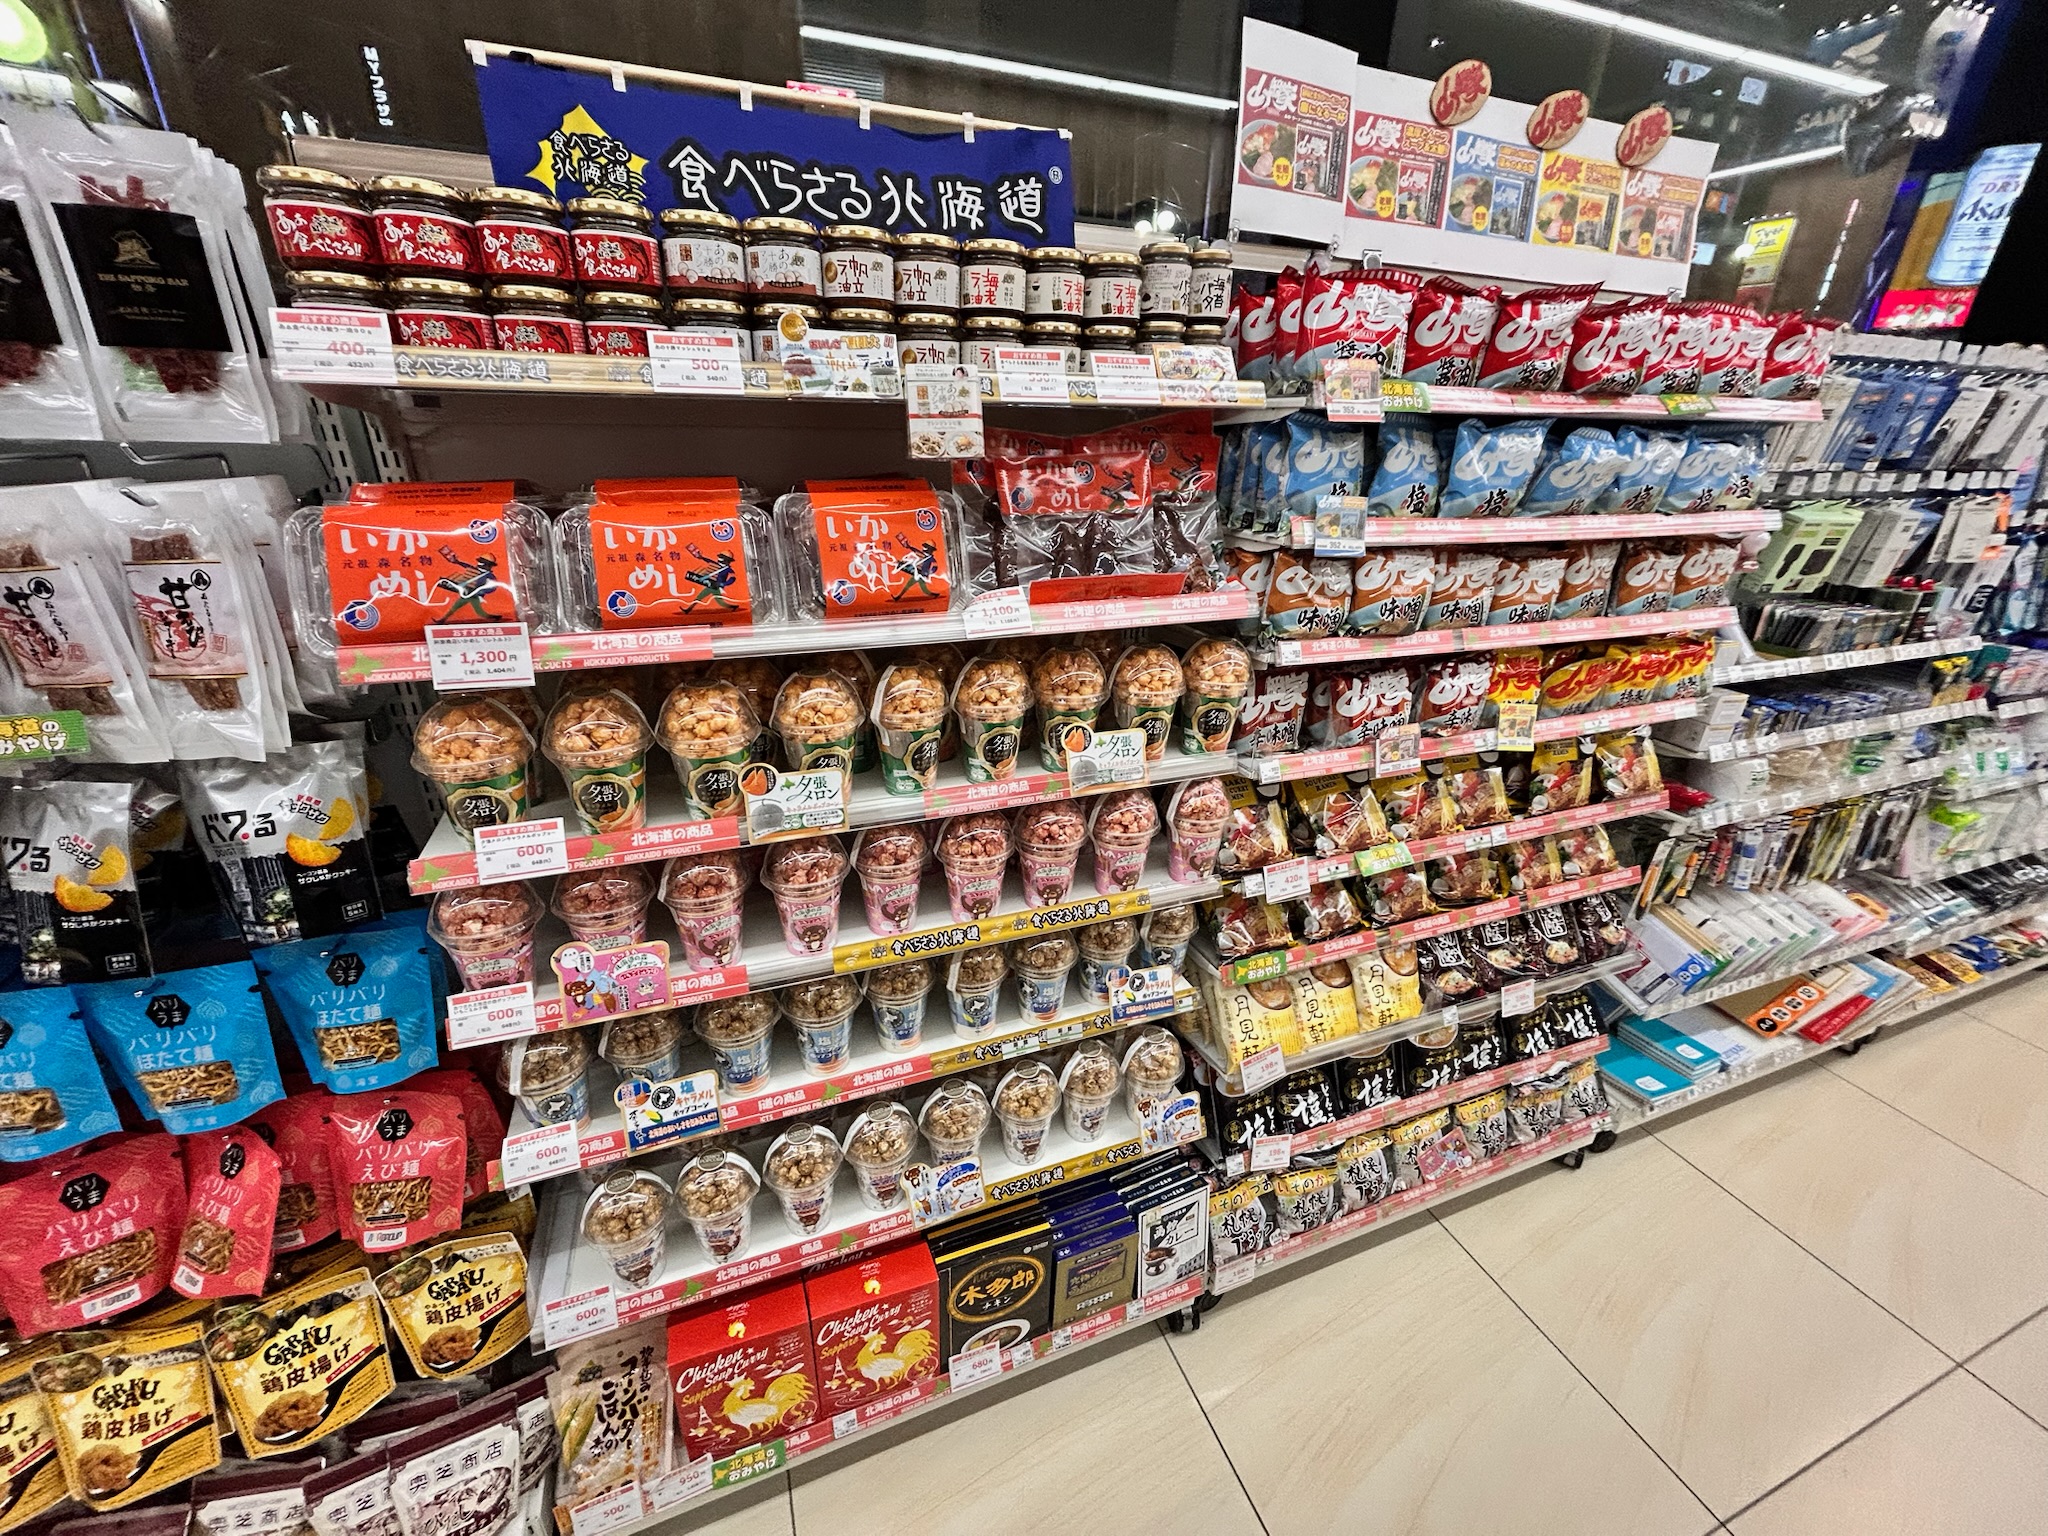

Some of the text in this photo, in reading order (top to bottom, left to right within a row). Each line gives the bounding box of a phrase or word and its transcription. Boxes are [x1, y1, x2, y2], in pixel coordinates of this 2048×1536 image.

[550, 129, 630, 162] 食べらさる
[553, 155, 629, 188] 北海道
[668, 144, 1045, 234] 食べらさる北海道
[97, 272, 190, 287] THE SAPPORO BAR
[395, 354, 551, 381] 食べらさる北海道
[1381, 383, 1420, 397] 北海道の
[1381, 396, 1424, 409] おみやげ
[1051, 488, 1092, 510] めし
[1405, 481, 1428, 516] 塩
[604, 526, 678, 551] いか
[826, 515, 889, 540] いか
[339, 528, 429, 556] いか
[369, 570, 450, 606] めし
[628, 564, 696, 598] めし
[1297, 607, 1345, 633] 味噌
[1379, 596, 1424, 625] 味噌
[1440, 598, 1484, 625] 味噌
[591, 633, 684, 651] 北海道の商品
[460, 650, 517, 665] 1,300円
[583, 653, 671, 668] HOKKAIDO PRODUCTS
[364, 670, 413, 683] HOKKAIDO
[1106, 734, 1133, 750] 夕張
[1112, 746, 1141, 759] メロン
[588, 784, 615, 797] 夕張
[797, 774, 827, 792] 夕張
[804, 785, 840, 803] メロン
[594, 789, 622, 803] メロン
[631, 823, 714, 847] 北海道の商品
[516, 844, 554, 858] 600円
[624, 844, 702, 863] HOKKAIDO PRODUCTS
[431, 878, 474, 892] HOKKAIDO
[1031, 900, 1111, 929] 食べらさる北海道
[891, 925, 981, 957] 食べらさる北海道
[334, 969, 357, 983] うま
[309, 984, 387, 1006] バリバリ
[1368, 964, 1394, 1028] 月見軒
[156, 1010, 182, 1023] うま
[315, 1005, 383, 1025] ほたて麺
[487, 1008, 523, 1022] 600円
[1298, 976, 1327, 1045] 月見軒
[127, 1024, 218, 1052] バリバリ
[136, 1045, 215, 1070] ほたて麺
[852, 1062, 914, 1087] 北海道の商品
[675, 1090, 715, 1105] キャラメル
[679, 1081, 696, 1095] 塩
[1357, 1073, 1388, 1108] 塩
[672, 1101, 710, 1117] ポップコーン
[1290, 1088, 1329, 1129] 塩
[535, 1145, 568, 1160] 600円
[1105, 1141, 1142, 1163] 食べらさる
[361, 1159, 421, 1181] えび麺
[71, 1190, 101, 1208] うま
[202, 1176, 244, 1206] バリバリ
[45, 1193, 142, 1241] バリバリ
[196, 1196, 232, 1226] えび麺
[57, 1217, 136, 1258] えび麺
[716, 1254, 781, 1282] 北海道の商品
[741, 1272, 772, 1288] PRODUCTS
[957, 1269, 1036, 1308] 木多郎
[425, 1284, 503, 1325] 鶏皮揚げ
[981, 1295, 1012, 1311] チキン
[816, 1302, 879, 1346] Chicken
[842, 1303, 902, 1343] Soup Curry
[261, 1339, 355, 1395] 鶏皮揚げ
[675, 1346, 744, 1396] Chicken
[704, 1369, 733, 1390] Soup
[733, 1346, 769, 1374] Curry
[81, 1405, 175, 1441] 鶏皮揚げ
[408, 1439, 505, 1495] 奥芝商店
[728, 1448, 776, 1470] 北海道の
[728, 1456, 778, 1482] おみやげ
